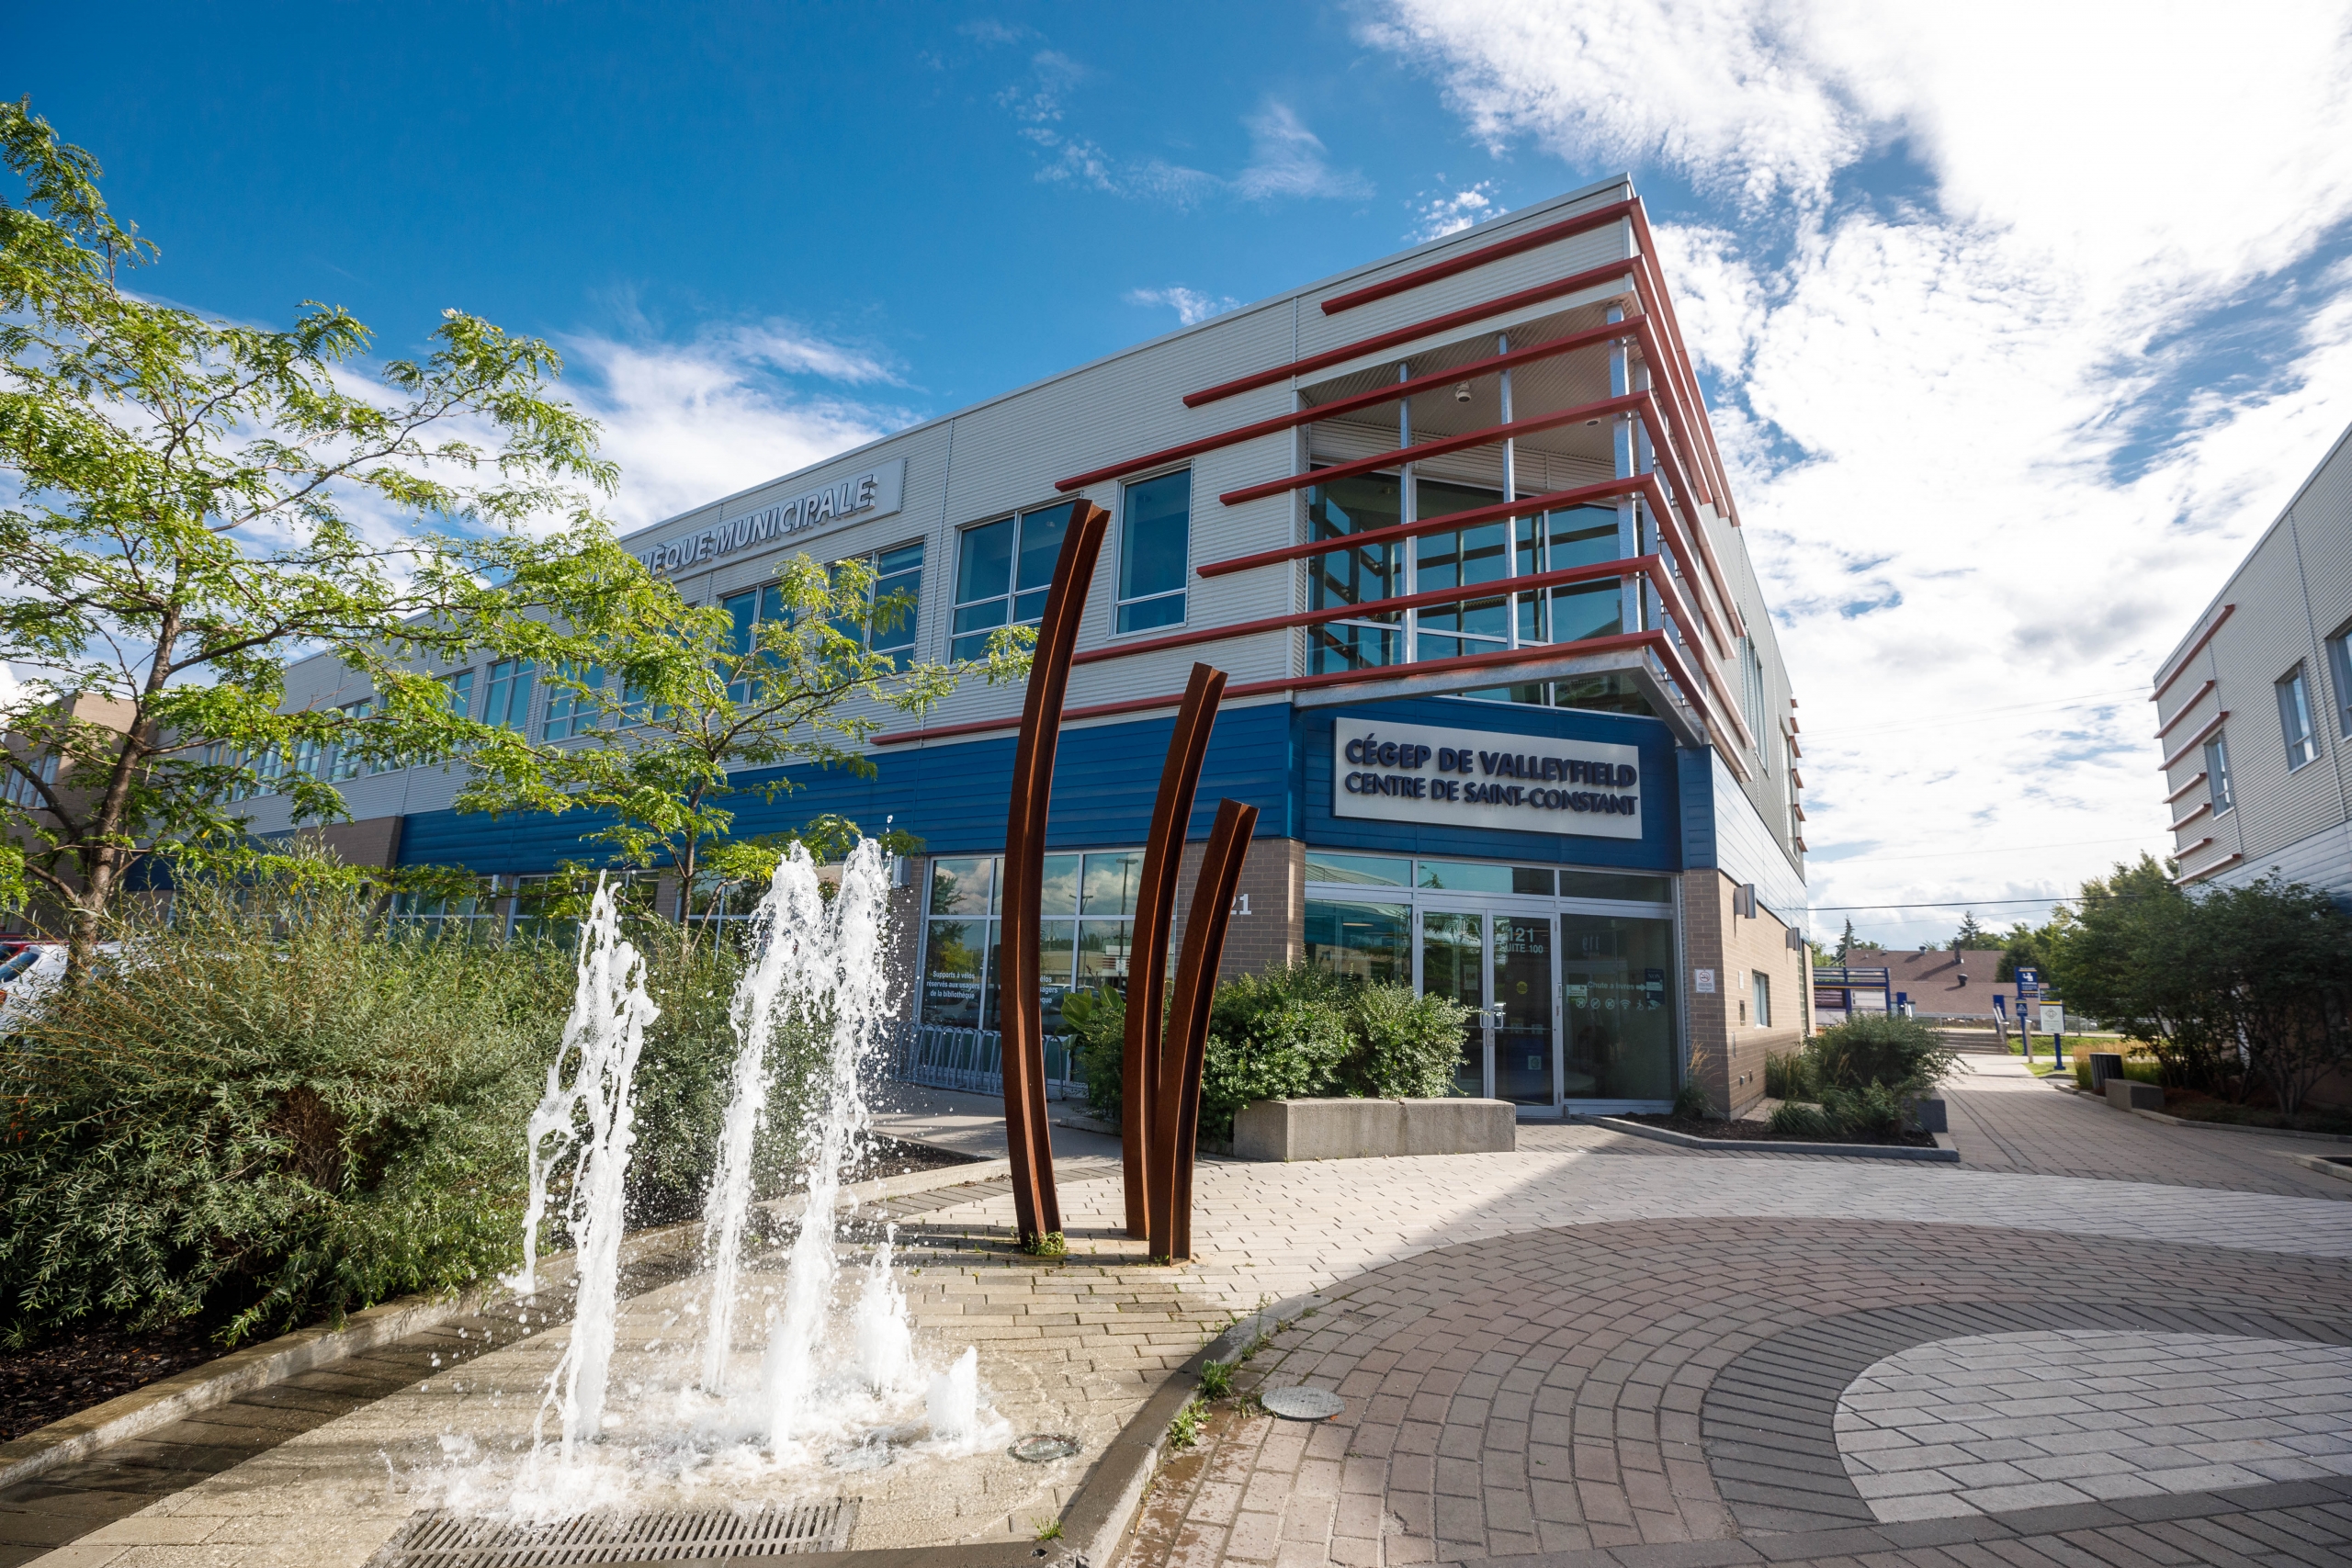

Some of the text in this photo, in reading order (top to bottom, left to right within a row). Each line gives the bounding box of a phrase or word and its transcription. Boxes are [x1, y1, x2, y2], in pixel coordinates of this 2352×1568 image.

[714, 474, 878, 557] MUNICIPALE
[1345, 732, 1637, 787] CÉGEP DE VALLEYFIELD
[1345, 771, 1638, 815] CENTRE DE SAINT-CONSTANT
[1508, 927, 1533, 942] 121
[1529, 944, 1544, 953] 100
[1588, 981, 1609, 989] Chute
